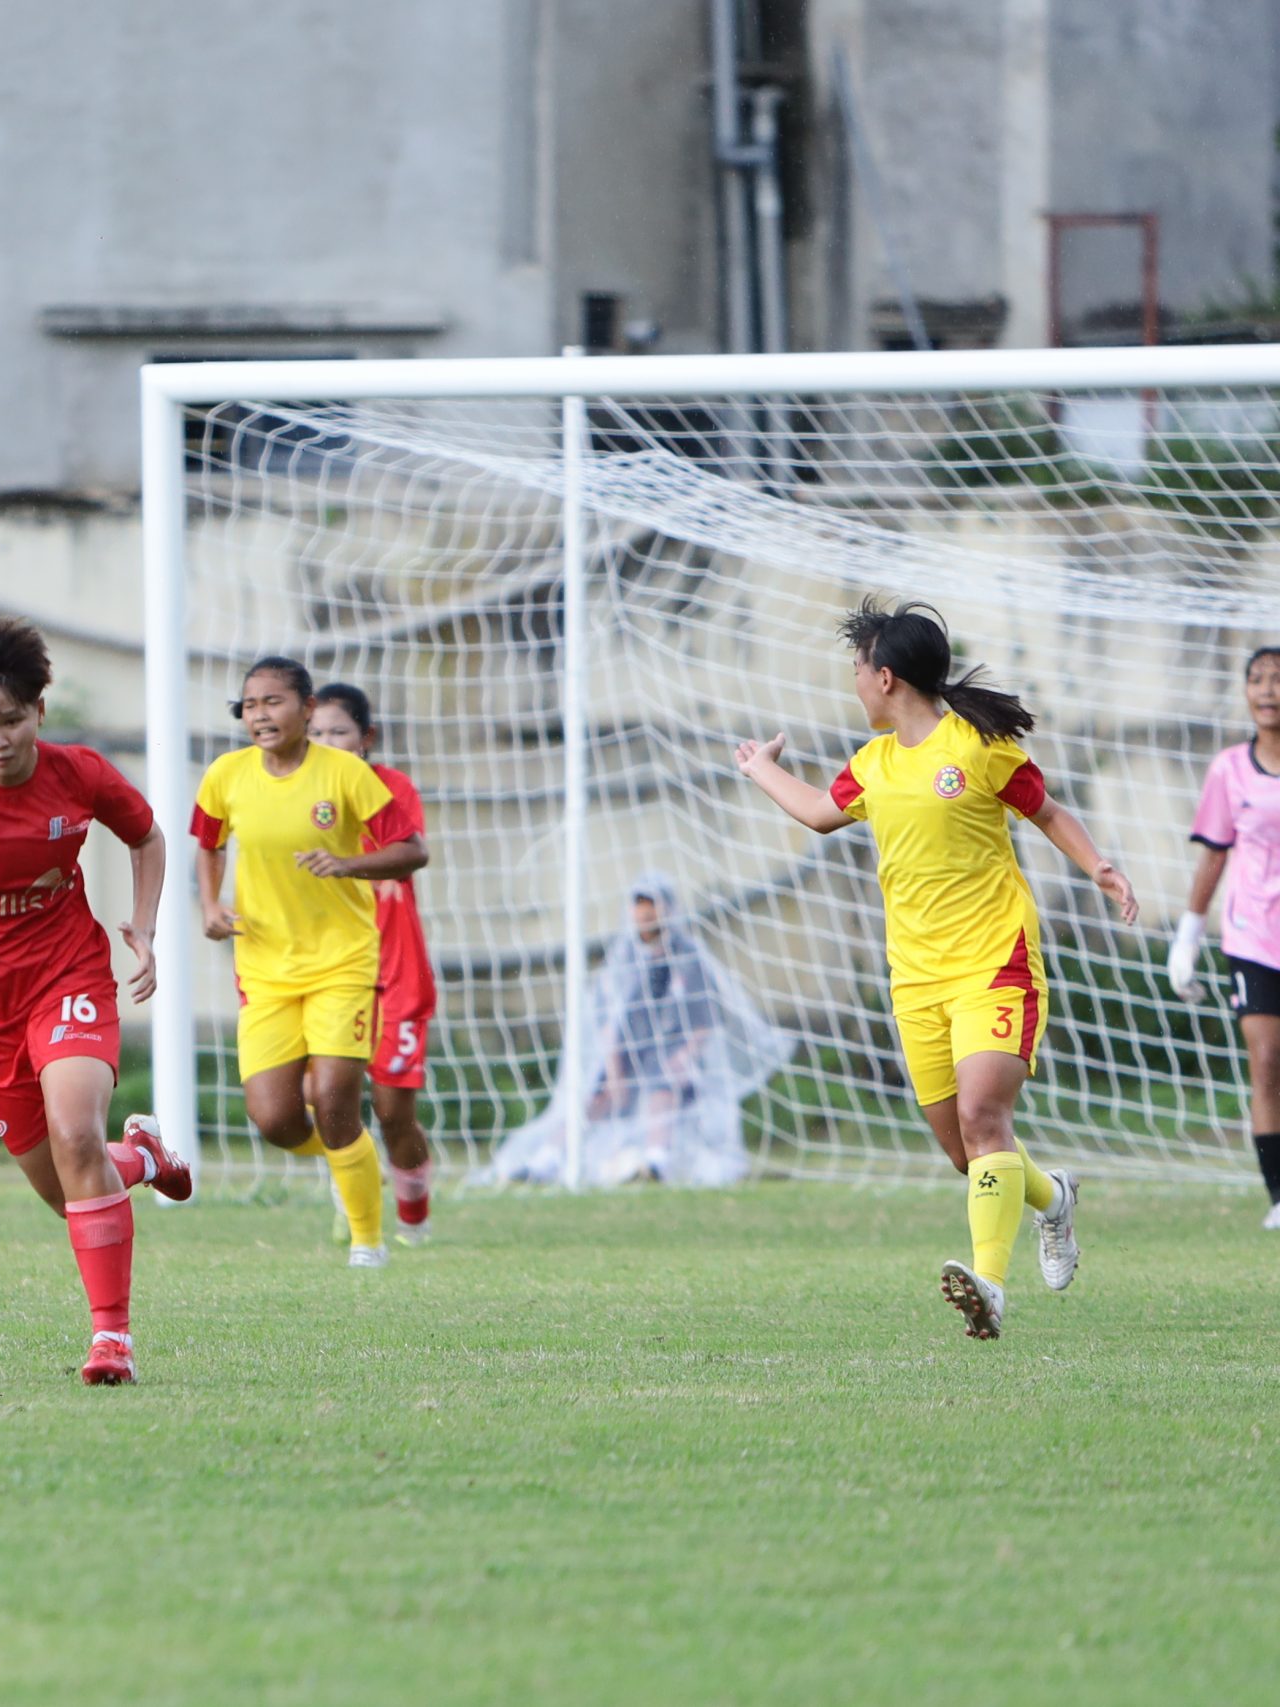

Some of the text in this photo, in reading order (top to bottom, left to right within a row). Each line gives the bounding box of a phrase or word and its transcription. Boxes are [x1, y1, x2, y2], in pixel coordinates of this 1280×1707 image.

[61, 993, 98, 1024] 16
[991, 1005, 1014, 1039] 3
[353, 1009, 366, 1042] 5
[398, 1020, 418, 1056] 5
